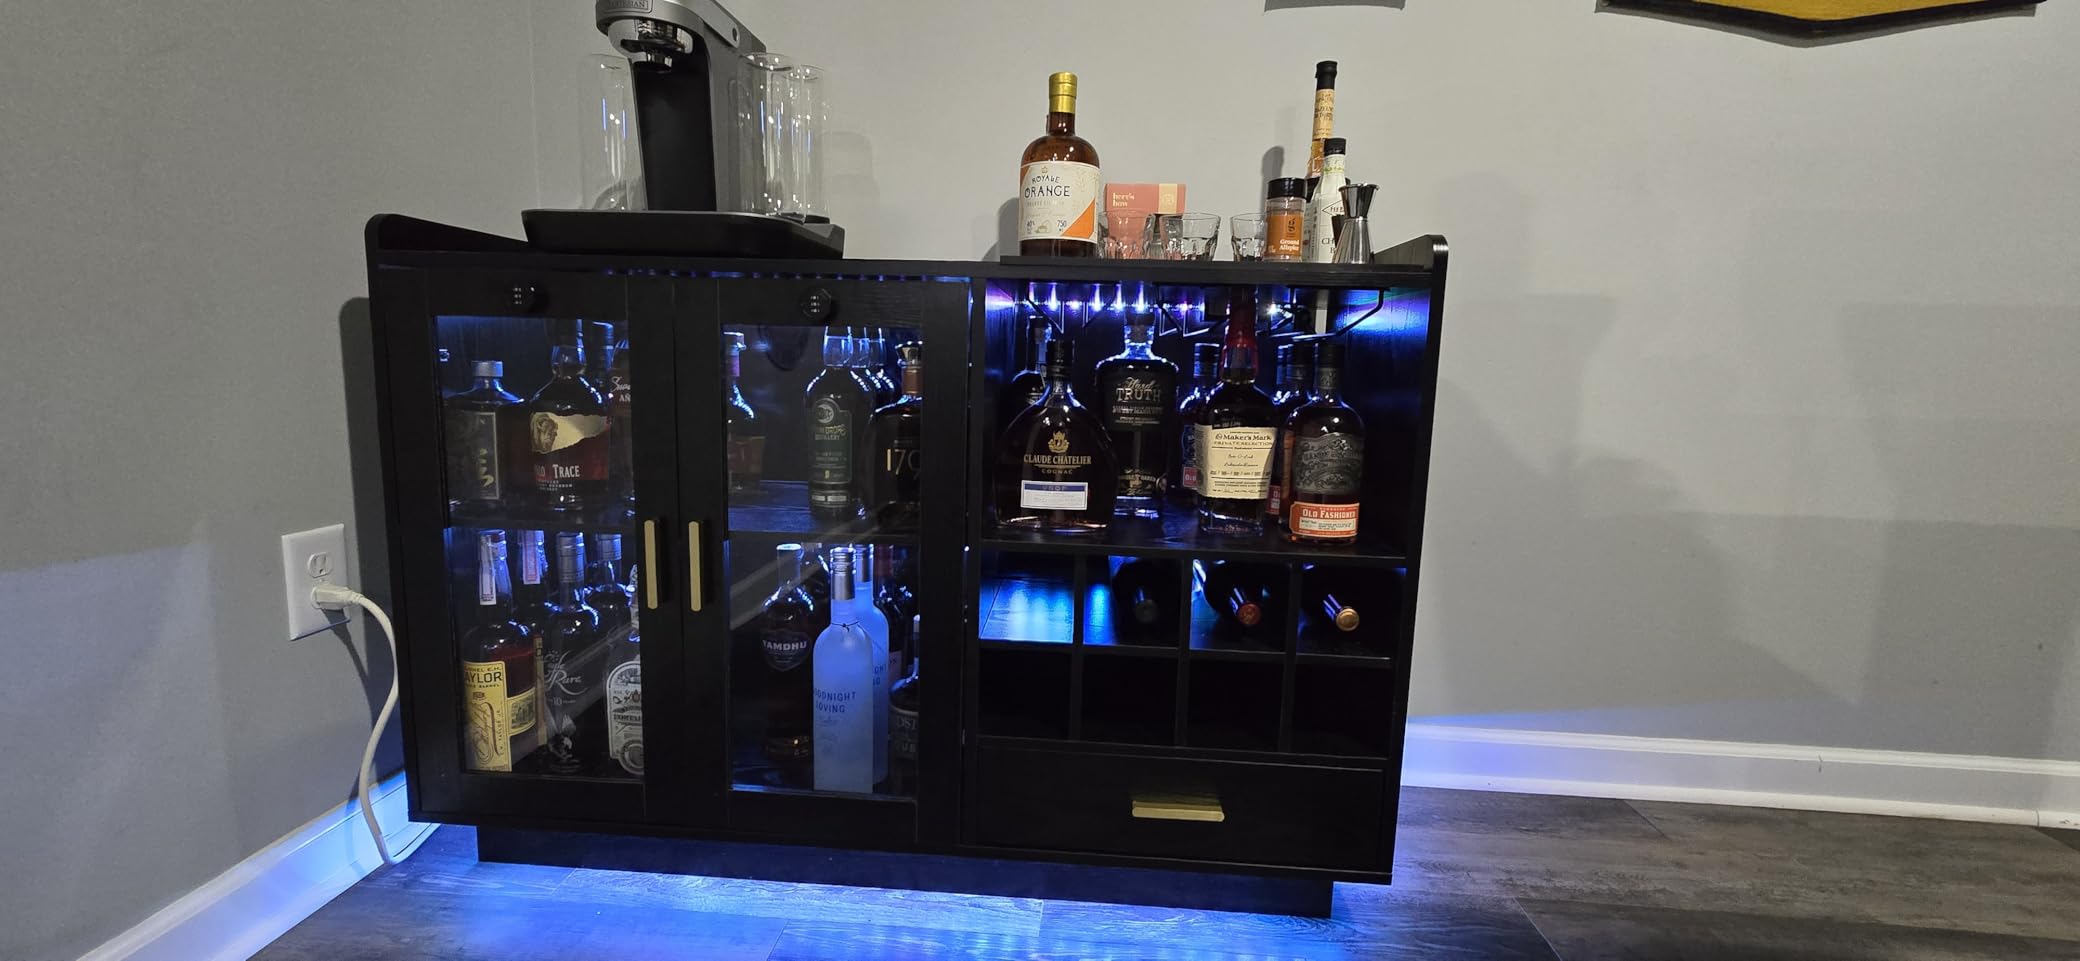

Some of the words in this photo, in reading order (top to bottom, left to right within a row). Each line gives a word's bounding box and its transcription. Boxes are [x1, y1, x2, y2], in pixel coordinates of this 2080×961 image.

[1025, 185, 1071, 199] ORANGE
[1115, 387, 1161, 402] TRUTH
[1023, 455, 1052, 465] CLAUDE
[1053, 455, 1092, 465] CHATELIER
[552, 464, 580, 479] TRACE
[1302, 508, 1318, 518] OLD
[762, 639, 808, 651] TAMDHU
